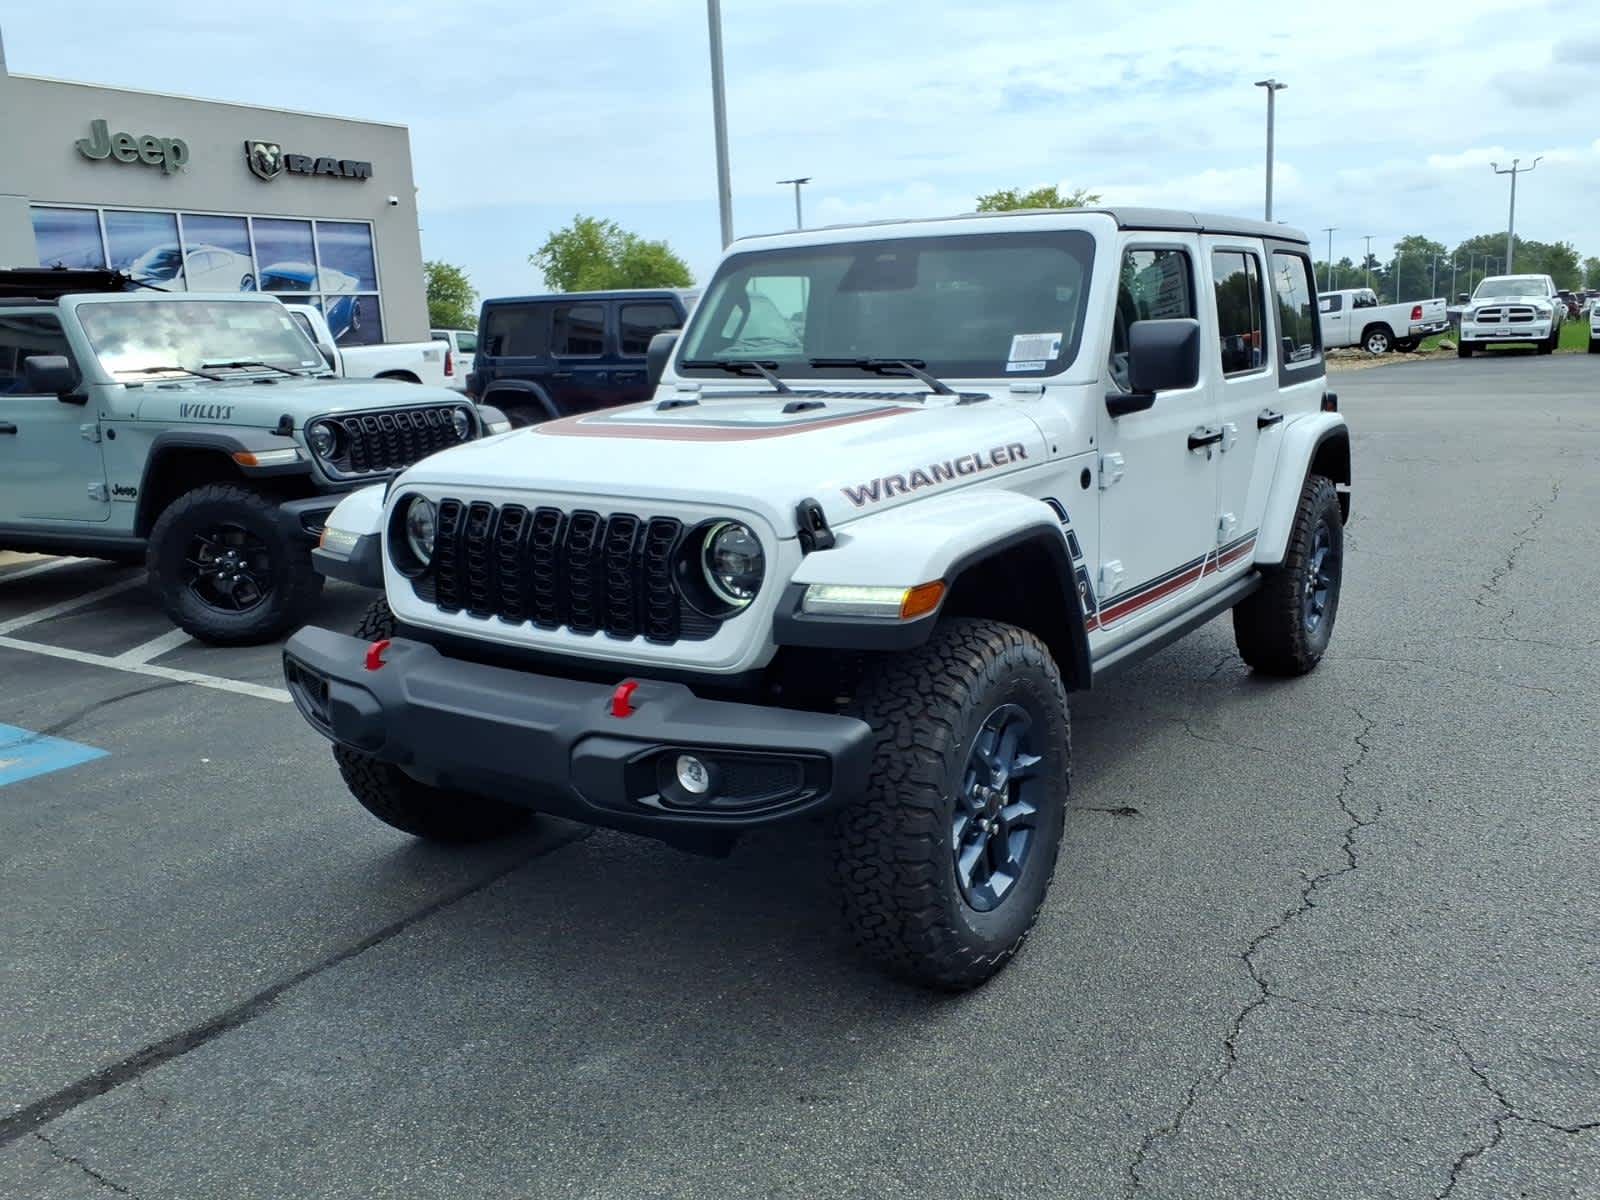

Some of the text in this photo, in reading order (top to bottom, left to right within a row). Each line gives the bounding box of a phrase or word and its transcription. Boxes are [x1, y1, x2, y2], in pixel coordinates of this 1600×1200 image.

[75, 118, 189, 175] Jeep
[283, 153, 373, 180] RAM
[179, 403, 235, 420] WILLYS
[840, 442, 1028, 508] WRANGLER
[111, 483, 137, 498] Jeep
